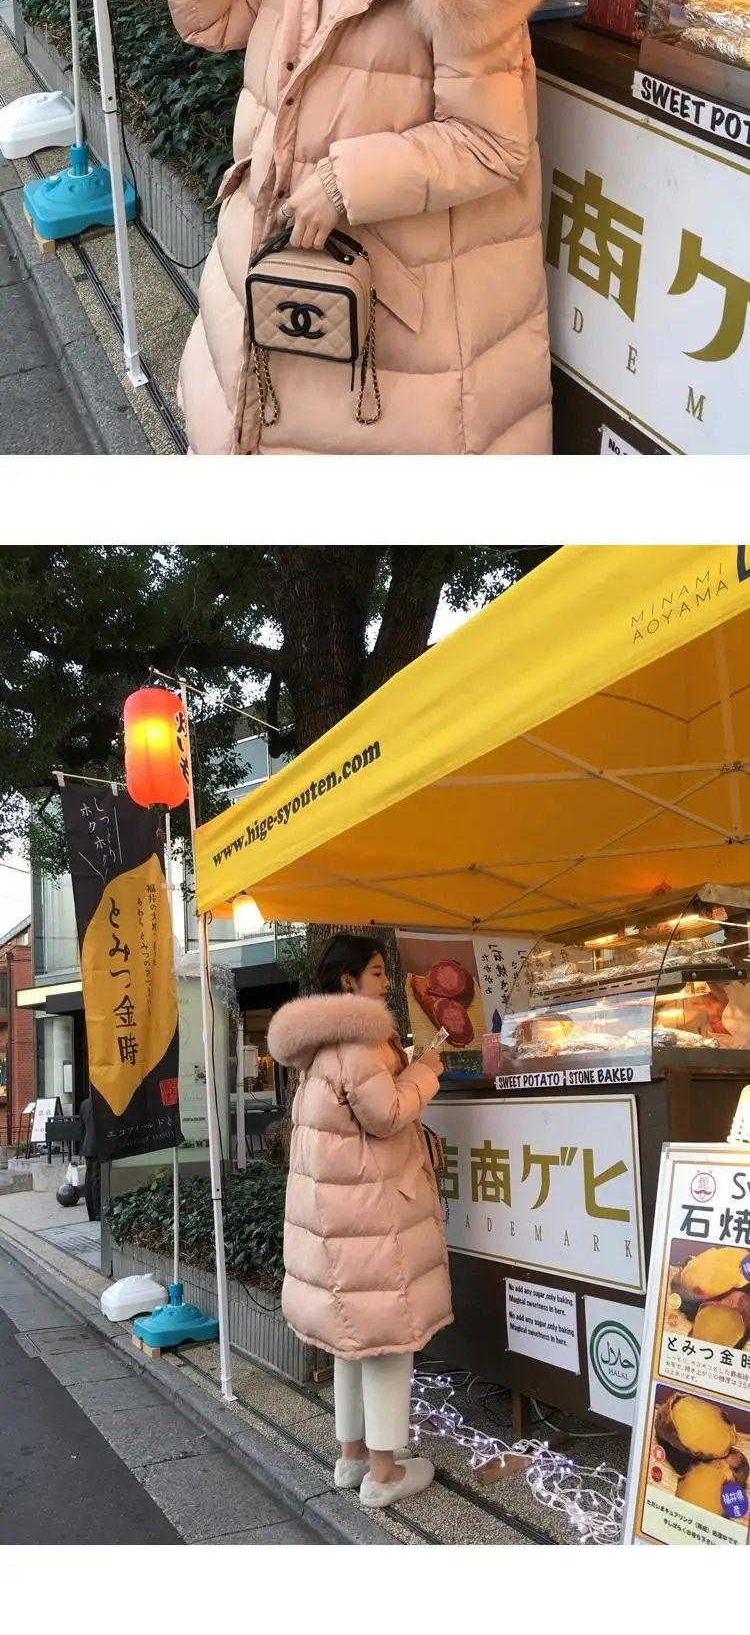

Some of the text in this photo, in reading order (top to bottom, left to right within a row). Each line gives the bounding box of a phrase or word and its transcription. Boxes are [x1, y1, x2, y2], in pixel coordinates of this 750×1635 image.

[641, 76, 705, 125] SWEET
[608, 437, 621, 455] No
[631, 563, 722, 628] MINAMI
[633, 580, 728, 645] AOYAMA
[212, 740, 381, 867] www.hige-syouten.com
[109, 896, 139, 1066] とみつ金時
[499, 1067, 633, 1089] SWEET POTATO STONE BAKED
[601, 1341, 635, 1368] حلال
[608, 1368, 629, 1381] HALAL
